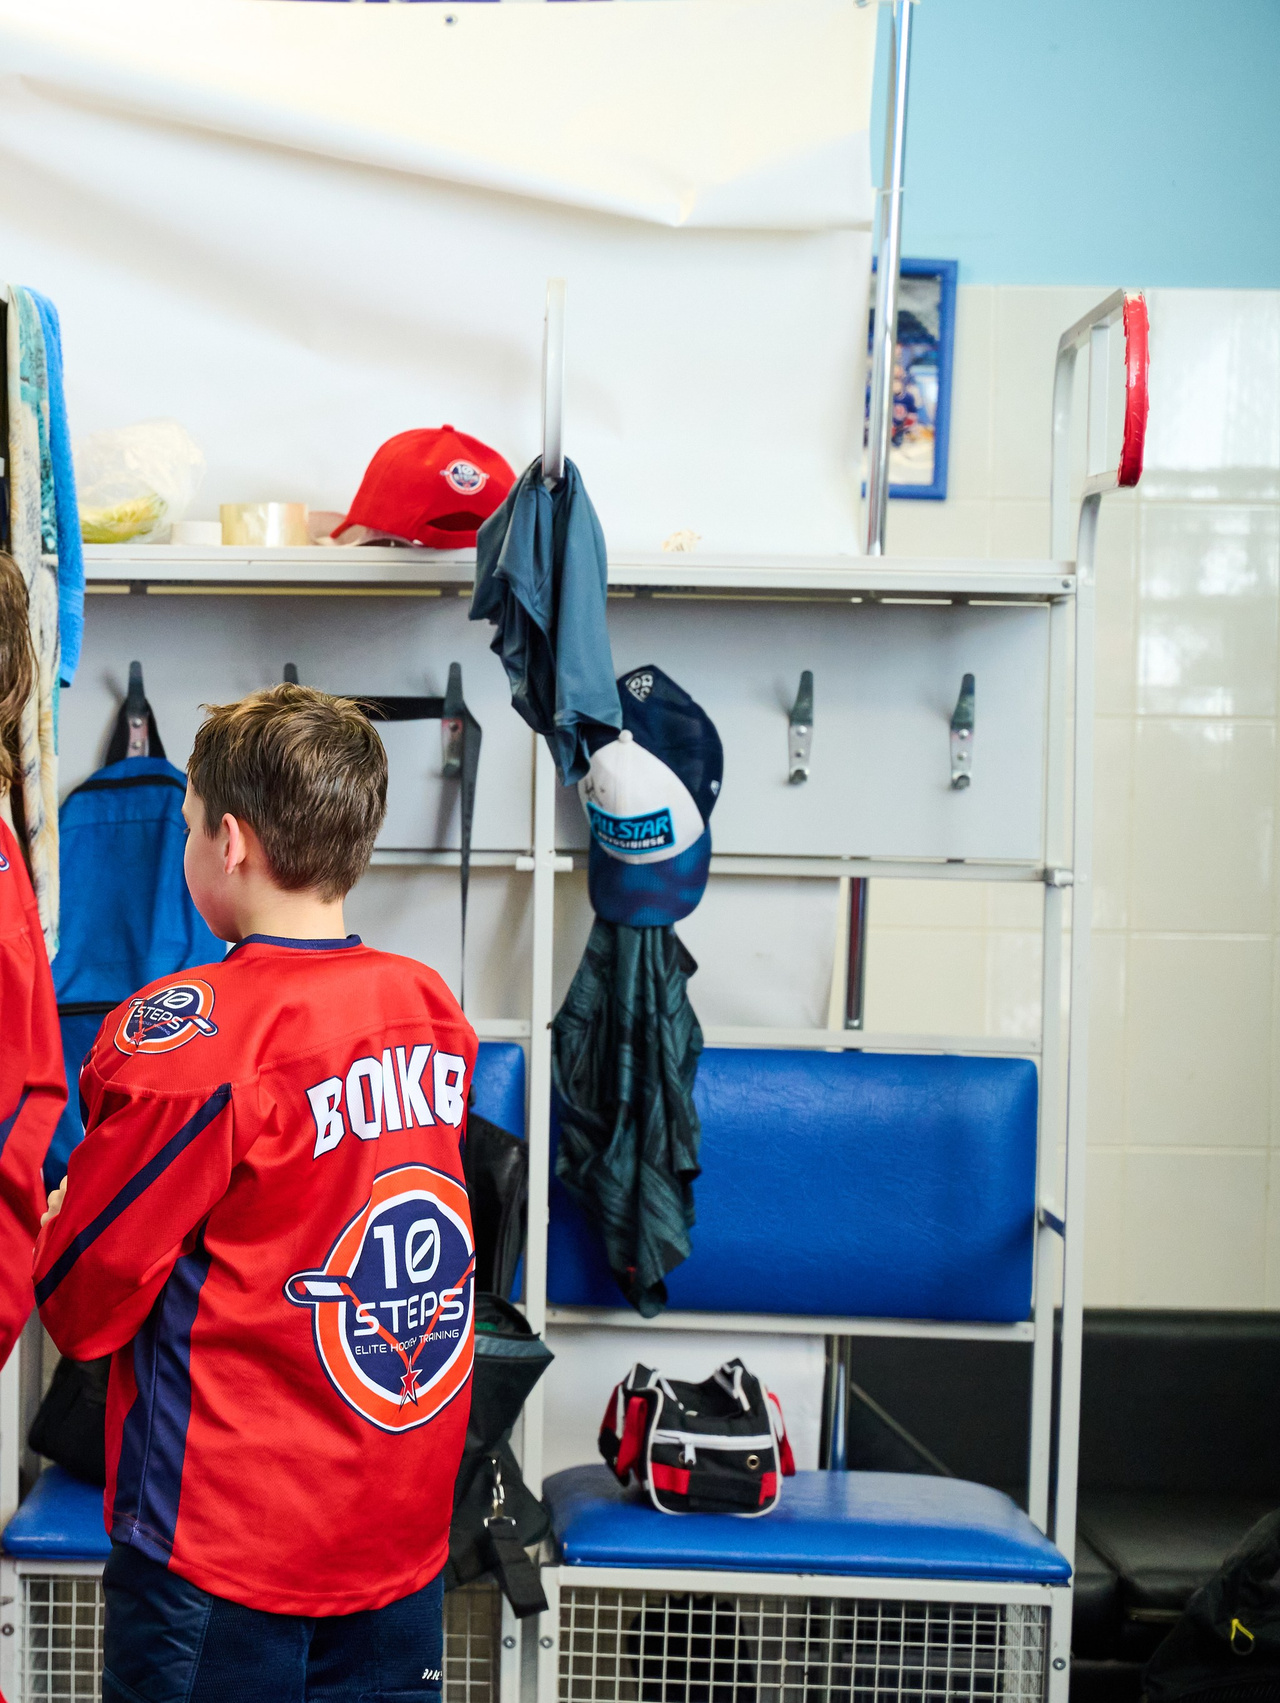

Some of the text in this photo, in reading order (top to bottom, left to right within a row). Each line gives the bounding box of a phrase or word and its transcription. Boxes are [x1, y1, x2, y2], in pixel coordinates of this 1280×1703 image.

[154, 989, 194, 1010] 10
[134, 1006, 184, 1030] STEPS
[373, 1218, 441, 1289] 10
[353, 1287, 465, 1337] STEPS
[355, 1344, 388, 1355] ELITE
[419, 1329, 460, 1343] TRAINING
